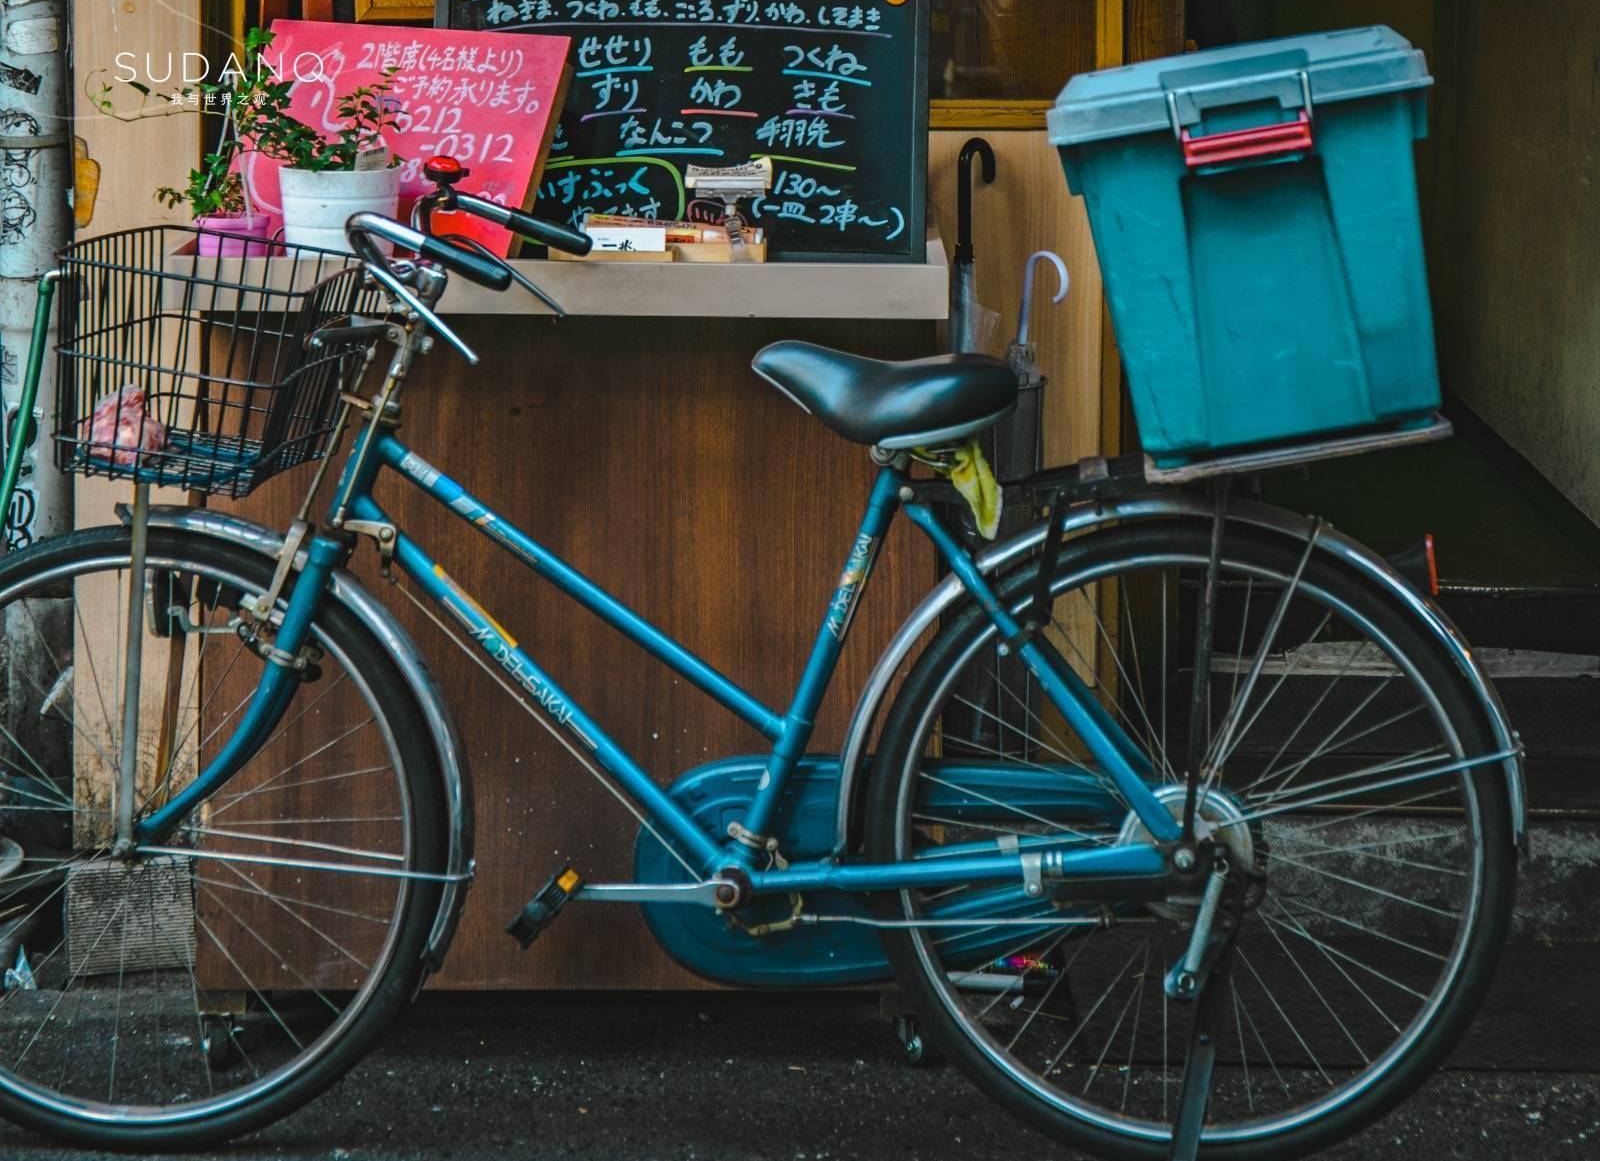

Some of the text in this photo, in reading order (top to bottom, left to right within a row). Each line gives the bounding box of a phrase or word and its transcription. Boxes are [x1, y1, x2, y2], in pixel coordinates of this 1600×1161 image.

[577, 35, 869, 76] せせり もも つくね
[591, 73, 640, 113] ずり
[689, 77, 743, 109] かわ
[619, 114, 846, 148] なんこつ 手羽先
